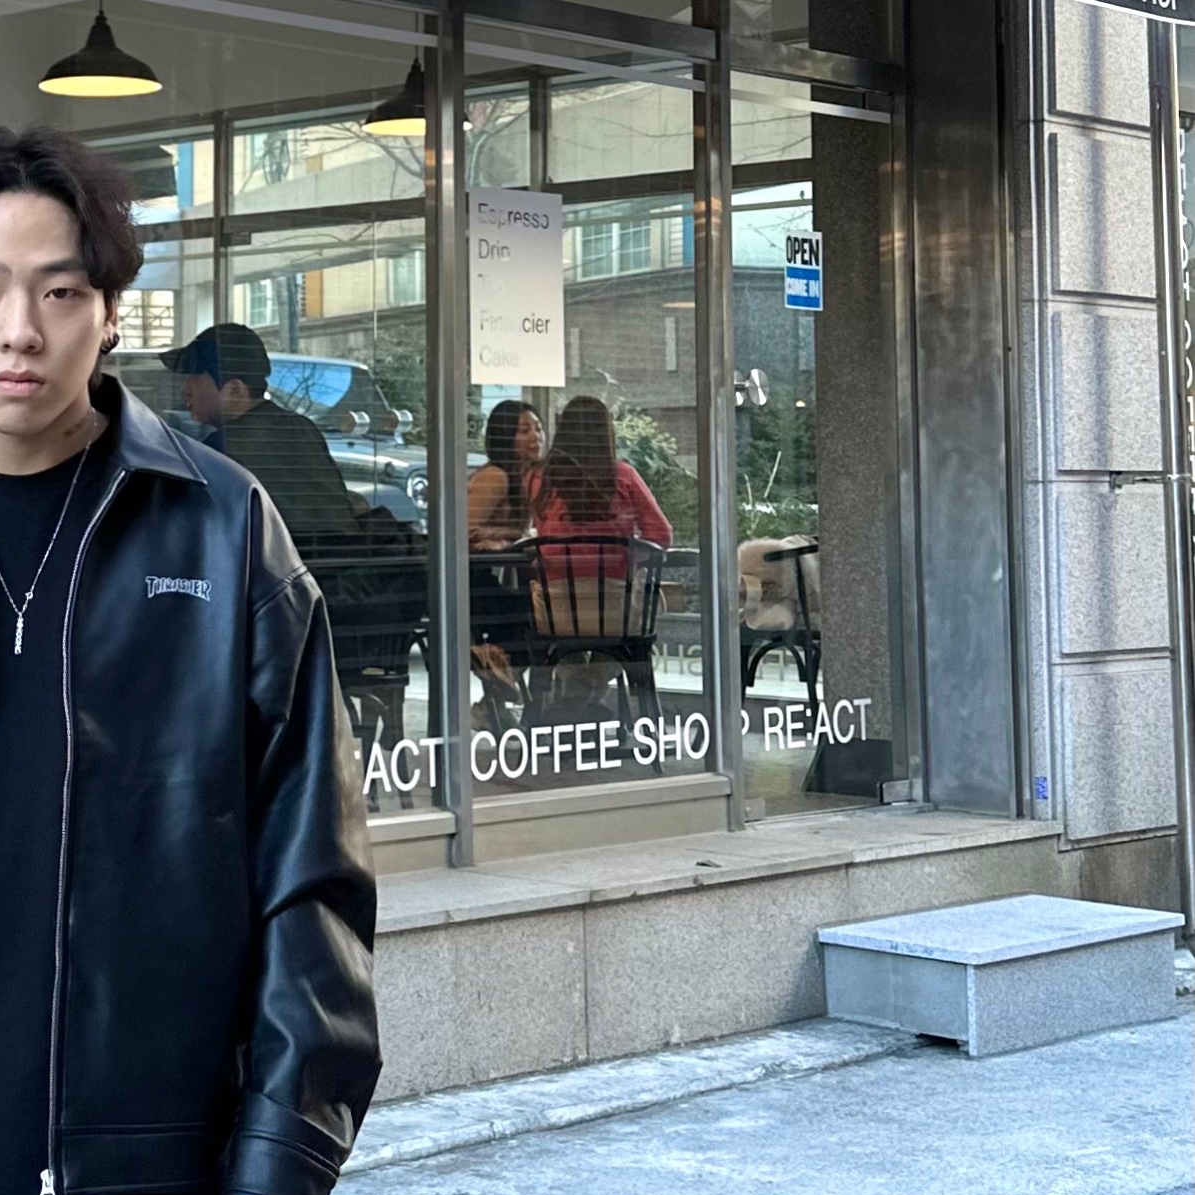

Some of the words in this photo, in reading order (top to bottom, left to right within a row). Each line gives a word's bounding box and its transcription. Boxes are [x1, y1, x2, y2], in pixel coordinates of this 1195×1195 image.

[478, 202, 550, 229] Espresso
[786, 235, 820, 267] OPEN
[480, 310, 550, 334] Fincier
[479, 345, 520, 368] Cake
[470, 721, 622, 782] COFFEE
[763, 698, 872, 752] RE:ACT
